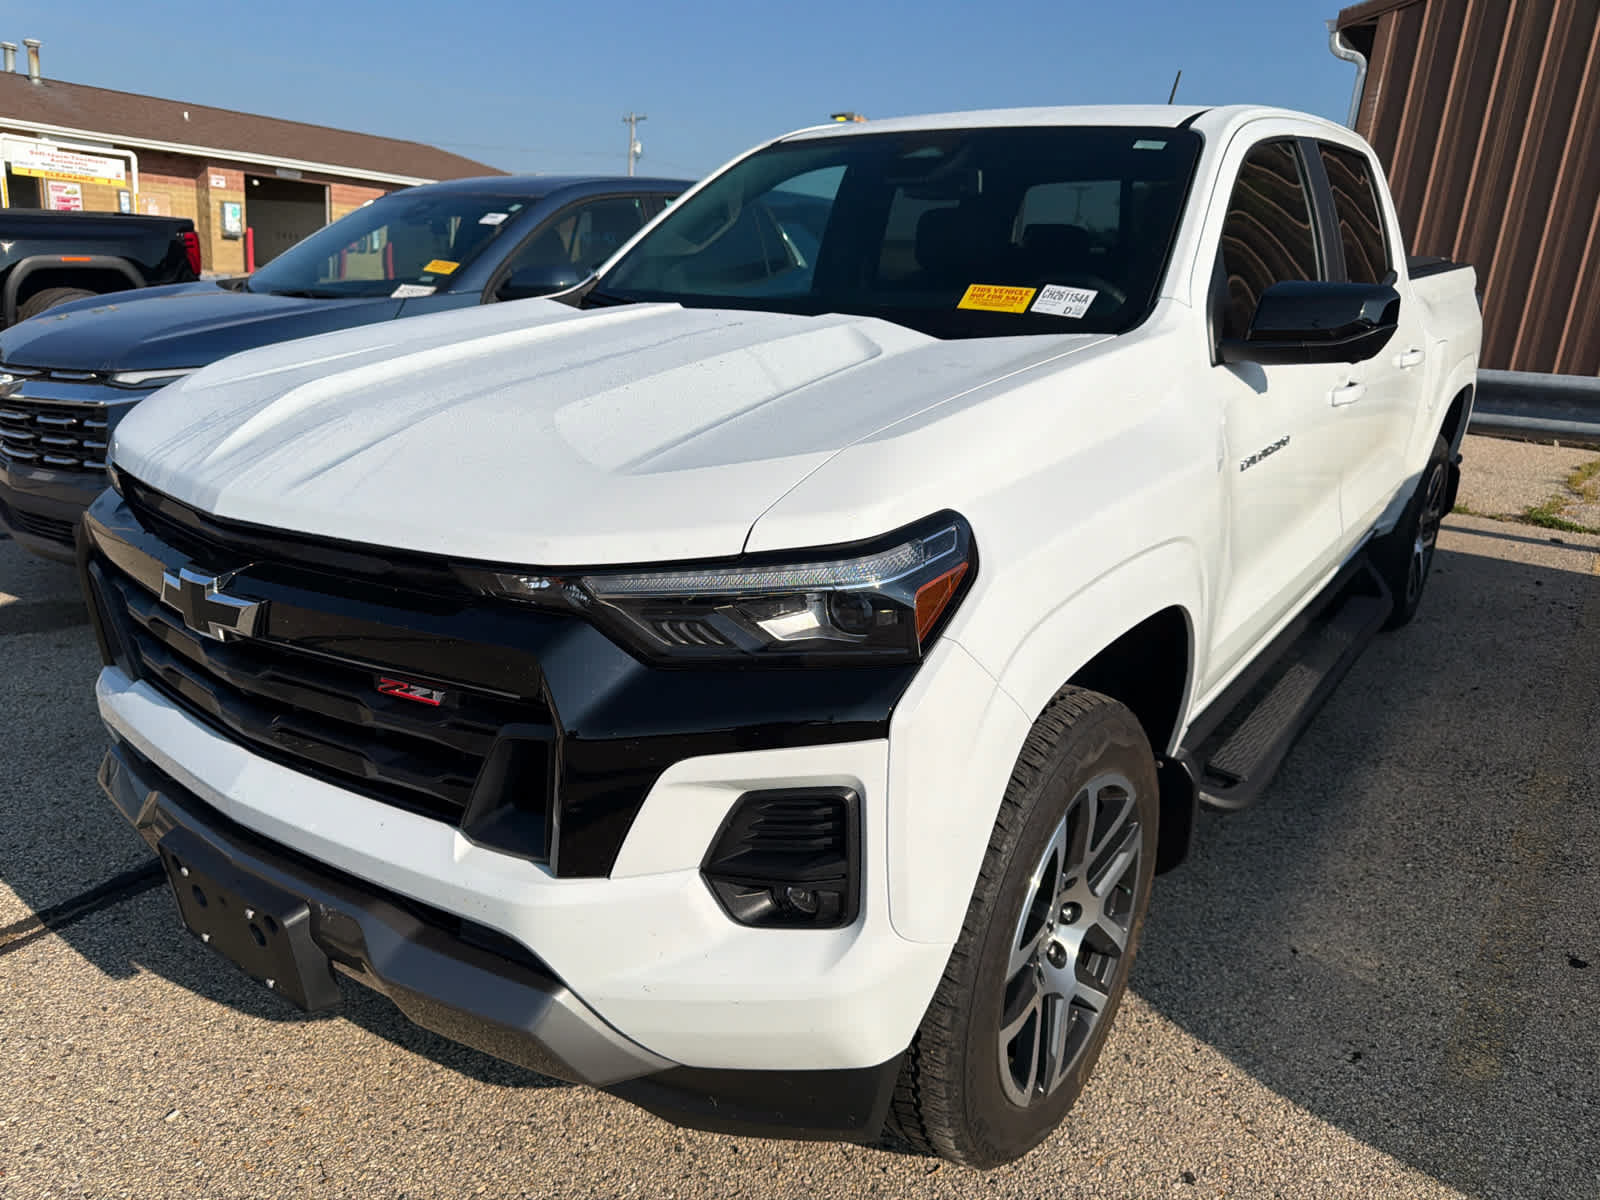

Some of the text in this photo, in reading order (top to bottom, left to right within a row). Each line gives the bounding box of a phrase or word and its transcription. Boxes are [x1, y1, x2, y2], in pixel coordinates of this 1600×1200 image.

[972, 286, 1031, 296] THIS VEHICLE
[987, 294, 1003, 302] FOR
[1005, 295, 1026, 304] SALE
[1063, 306, 1073, 315] D
[377, 677, 446, 707] Z71
